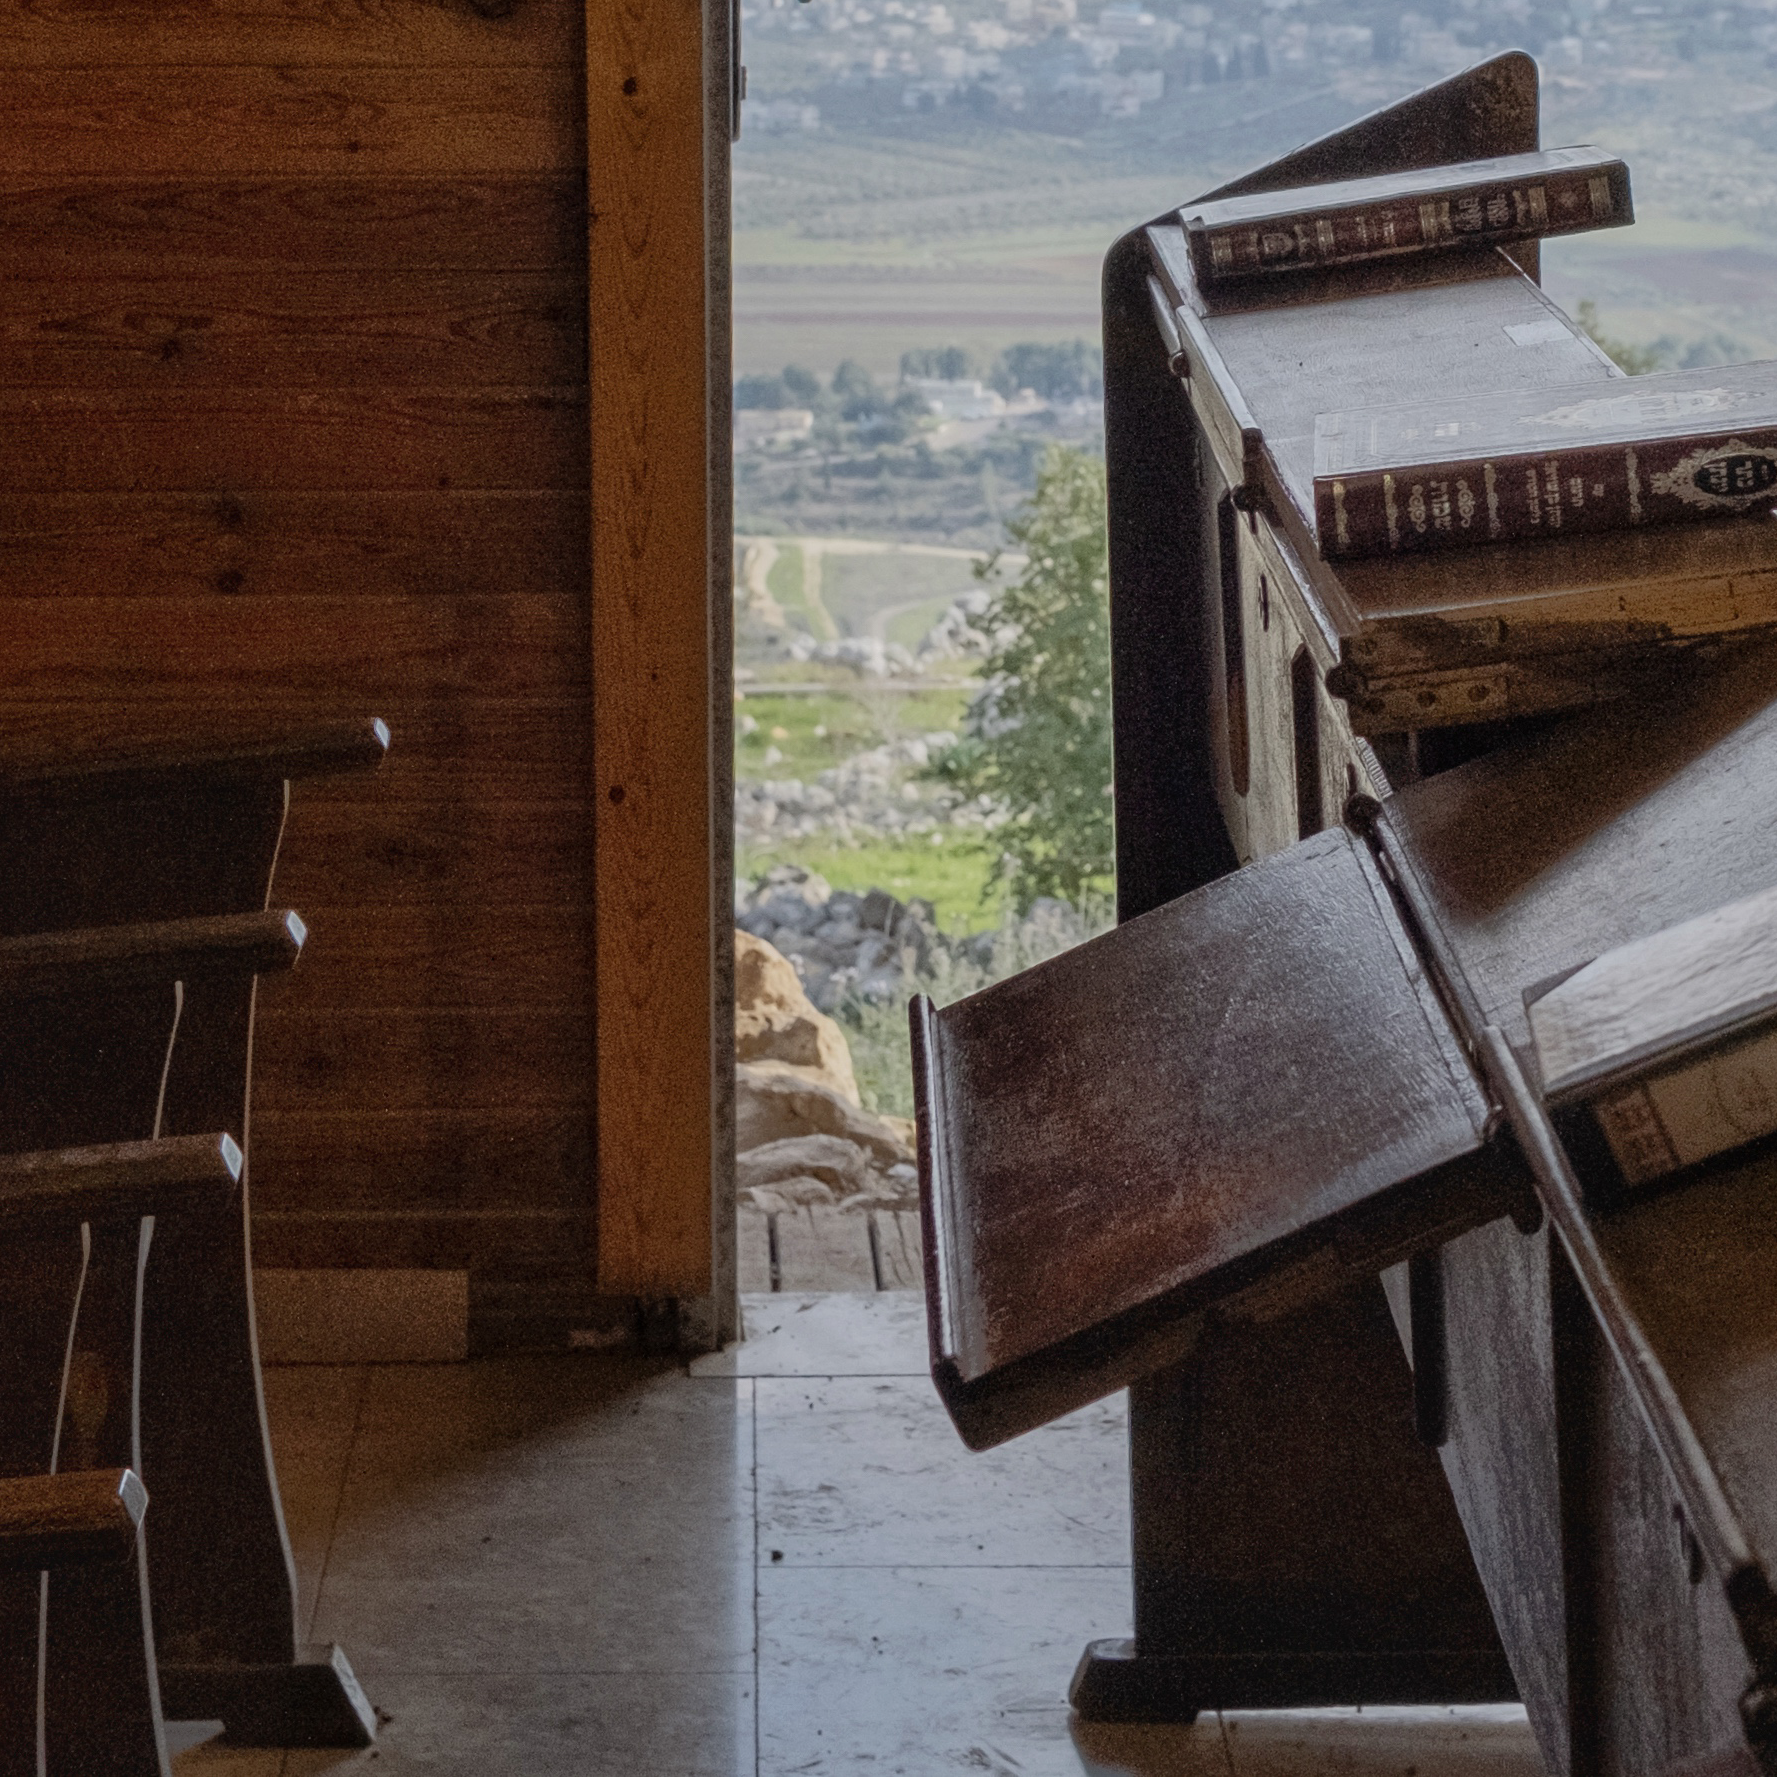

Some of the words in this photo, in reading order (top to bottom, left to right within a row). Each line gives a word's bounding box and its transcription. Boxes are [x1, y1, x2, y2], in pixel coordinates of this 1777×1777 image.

[1702, 462, 1728, 493] יונתן
[1733, 460, 1754, 489] כתר
[1428, 478, 1453, 532] שמות
